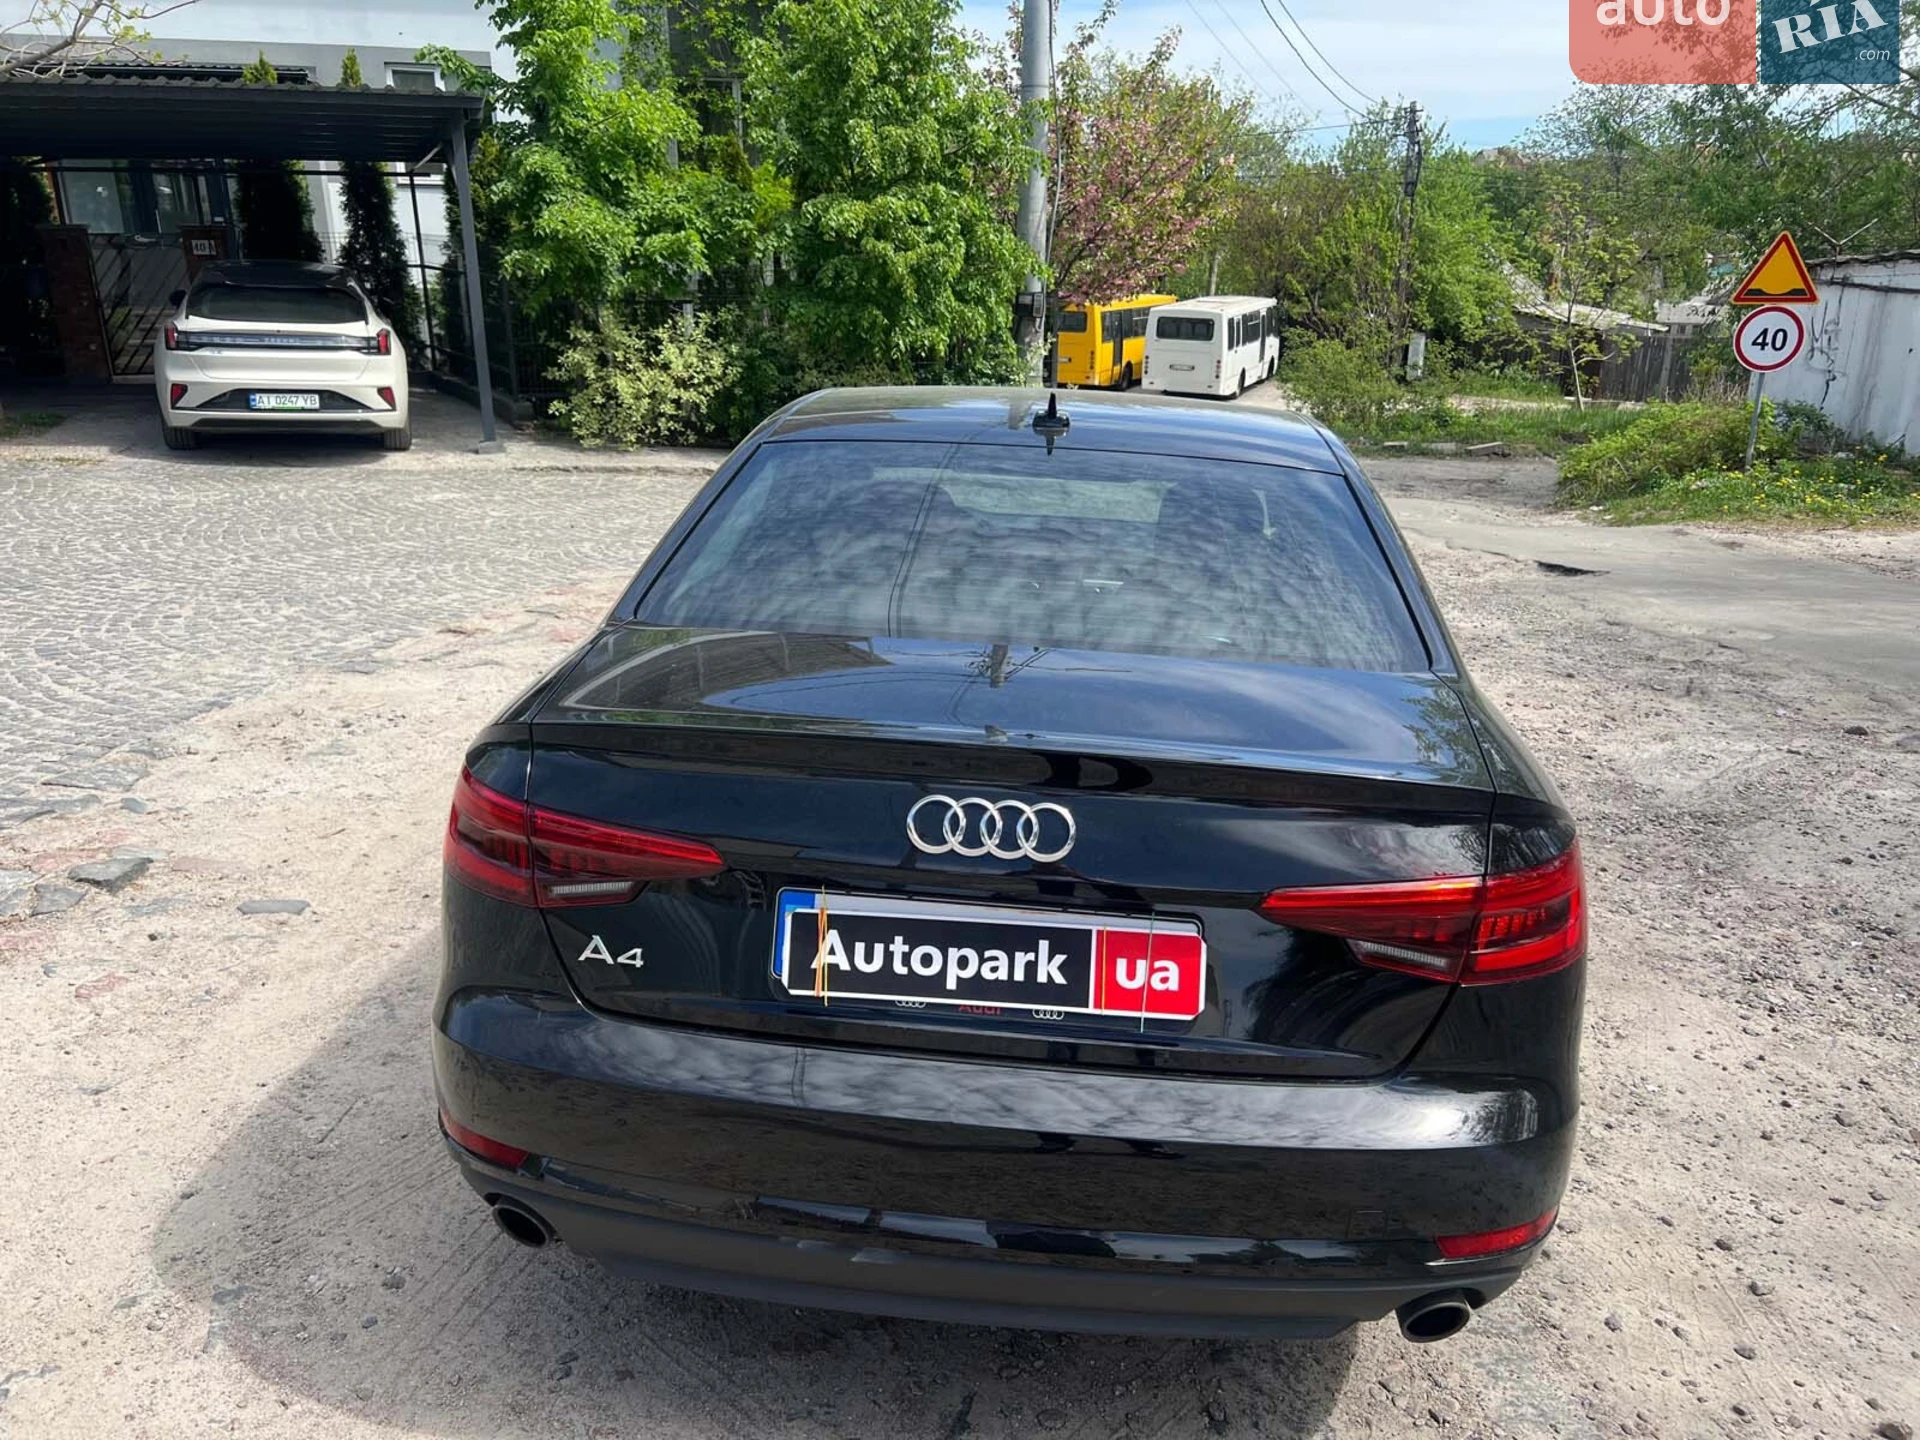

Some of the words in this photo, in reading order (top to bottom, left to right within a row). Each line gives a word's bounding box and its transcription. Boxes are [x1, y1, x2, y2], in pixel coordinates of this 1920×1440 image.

[1751, 327, 1788, 352] 40
[578, 934, 644, 968] A4
[811, 929, 1068, 990] Autopark
[1115, 957, 1180, 992] ua
